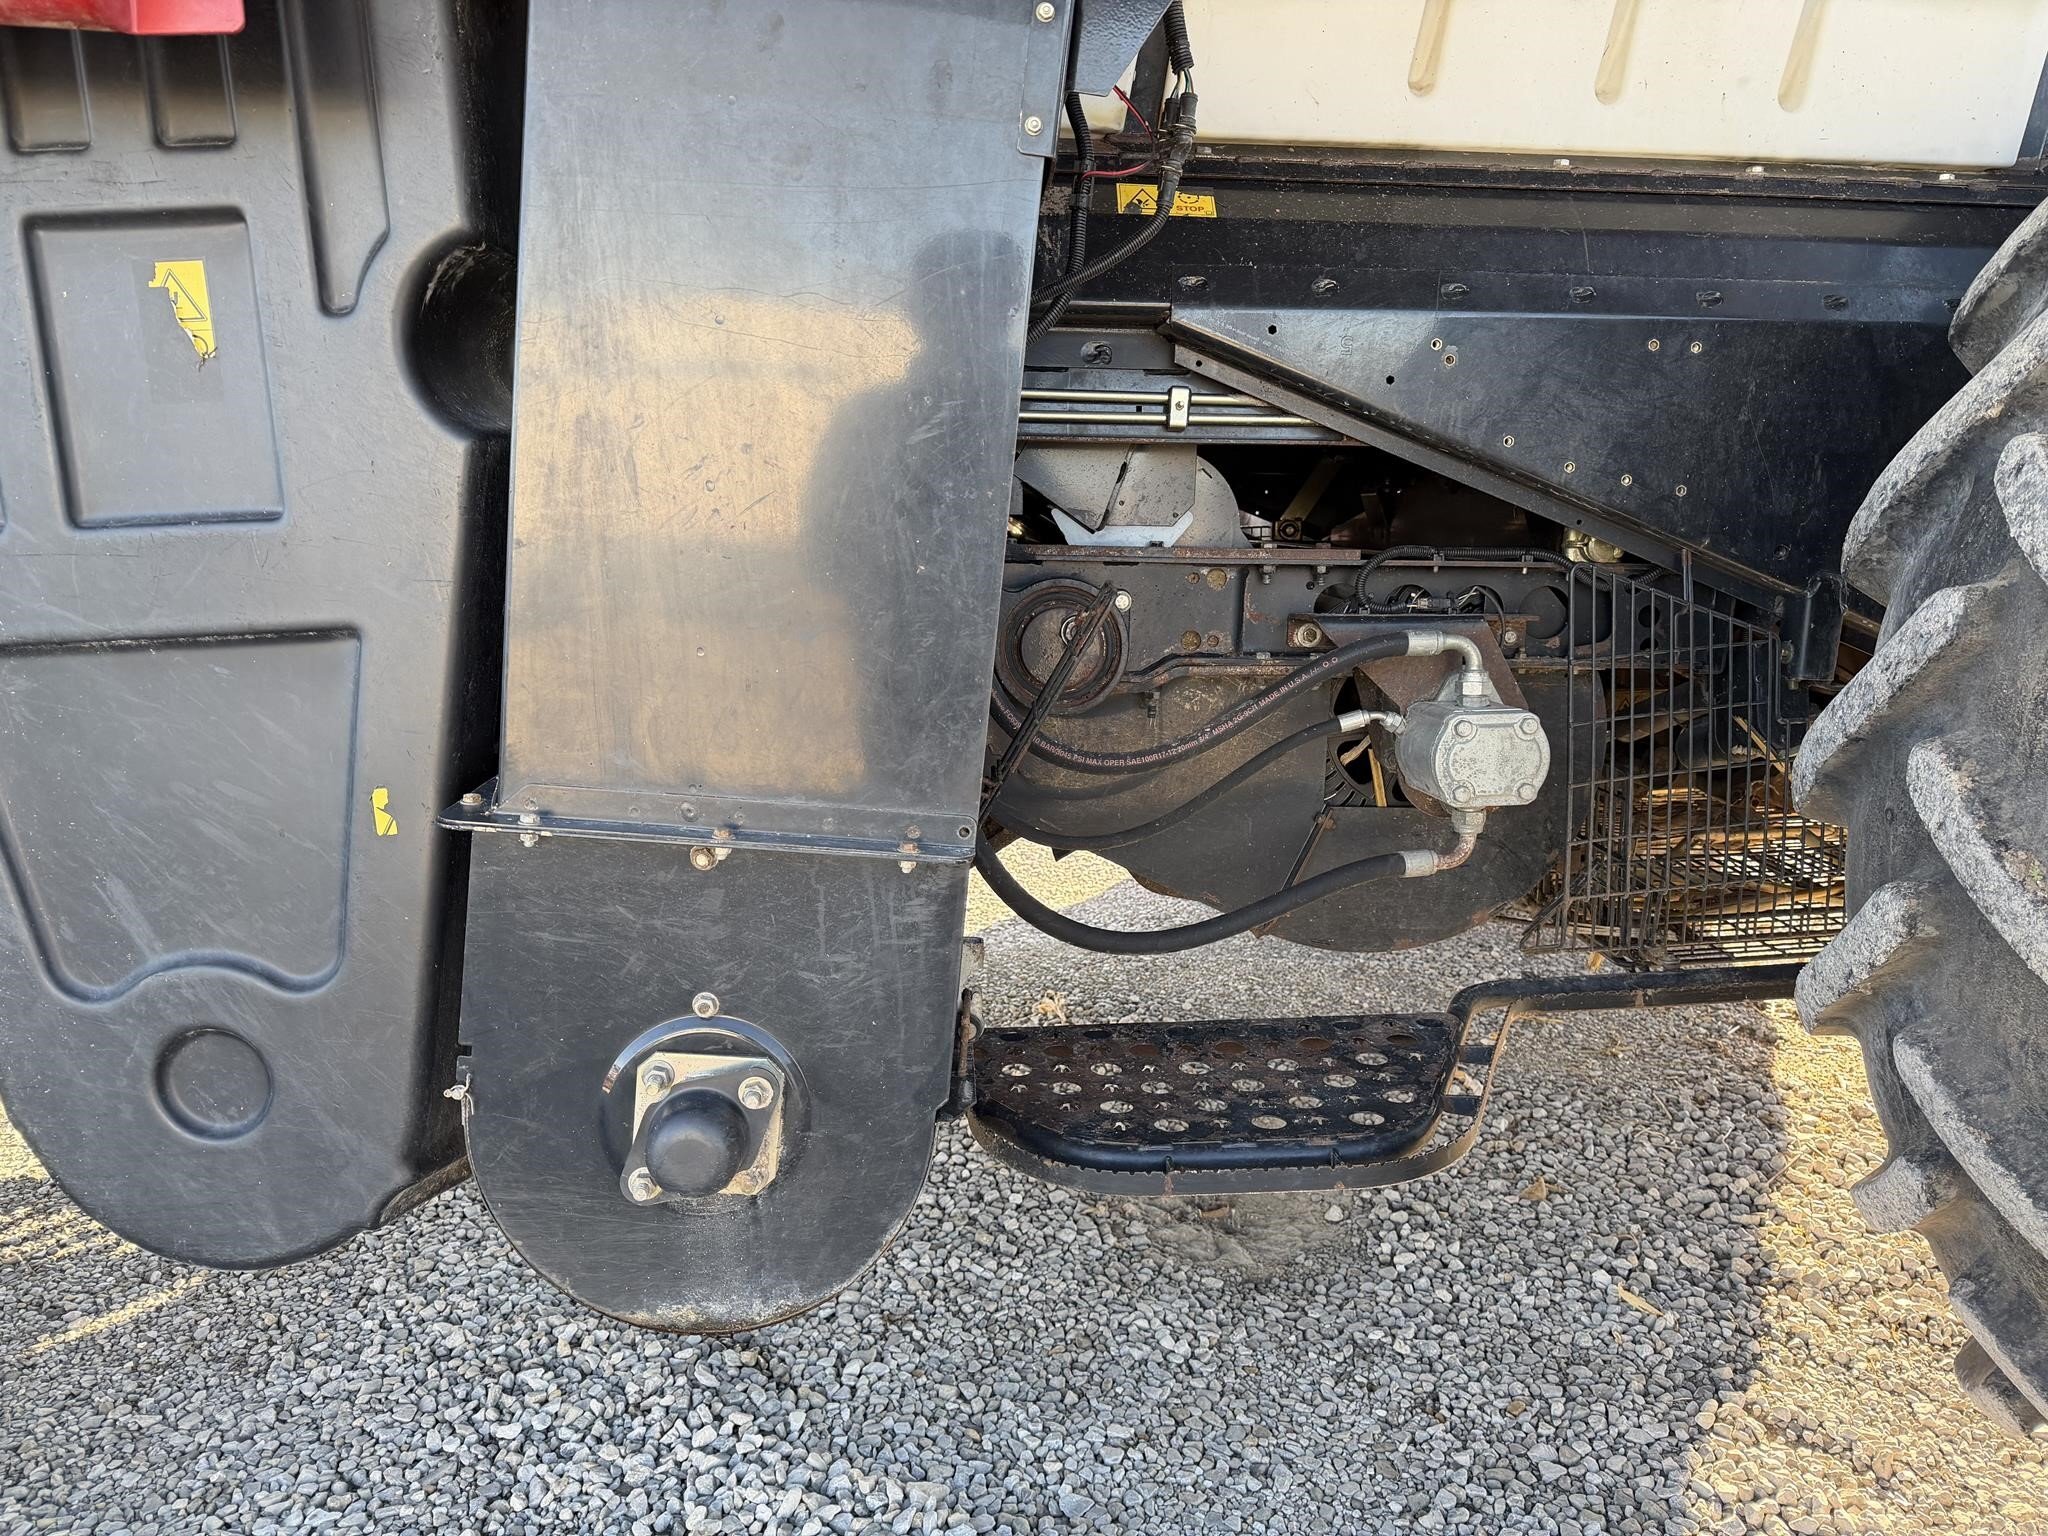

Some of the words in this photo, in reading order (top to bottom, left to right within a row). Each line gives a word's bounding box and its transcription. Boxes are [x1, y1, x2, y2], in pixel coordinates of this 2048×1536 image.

[1176, 205, 1205, 213] STOP
[1073, 754, 1085, 763] PSI
[1086, 757, 1102, 766] MAX
[1103, 759, 1125, 767] OPER
[1211, 720, 1234, 736] MSHA
[1258, 690, 1280, 707] MADE
[1279, 684, 1289, 695] IN
